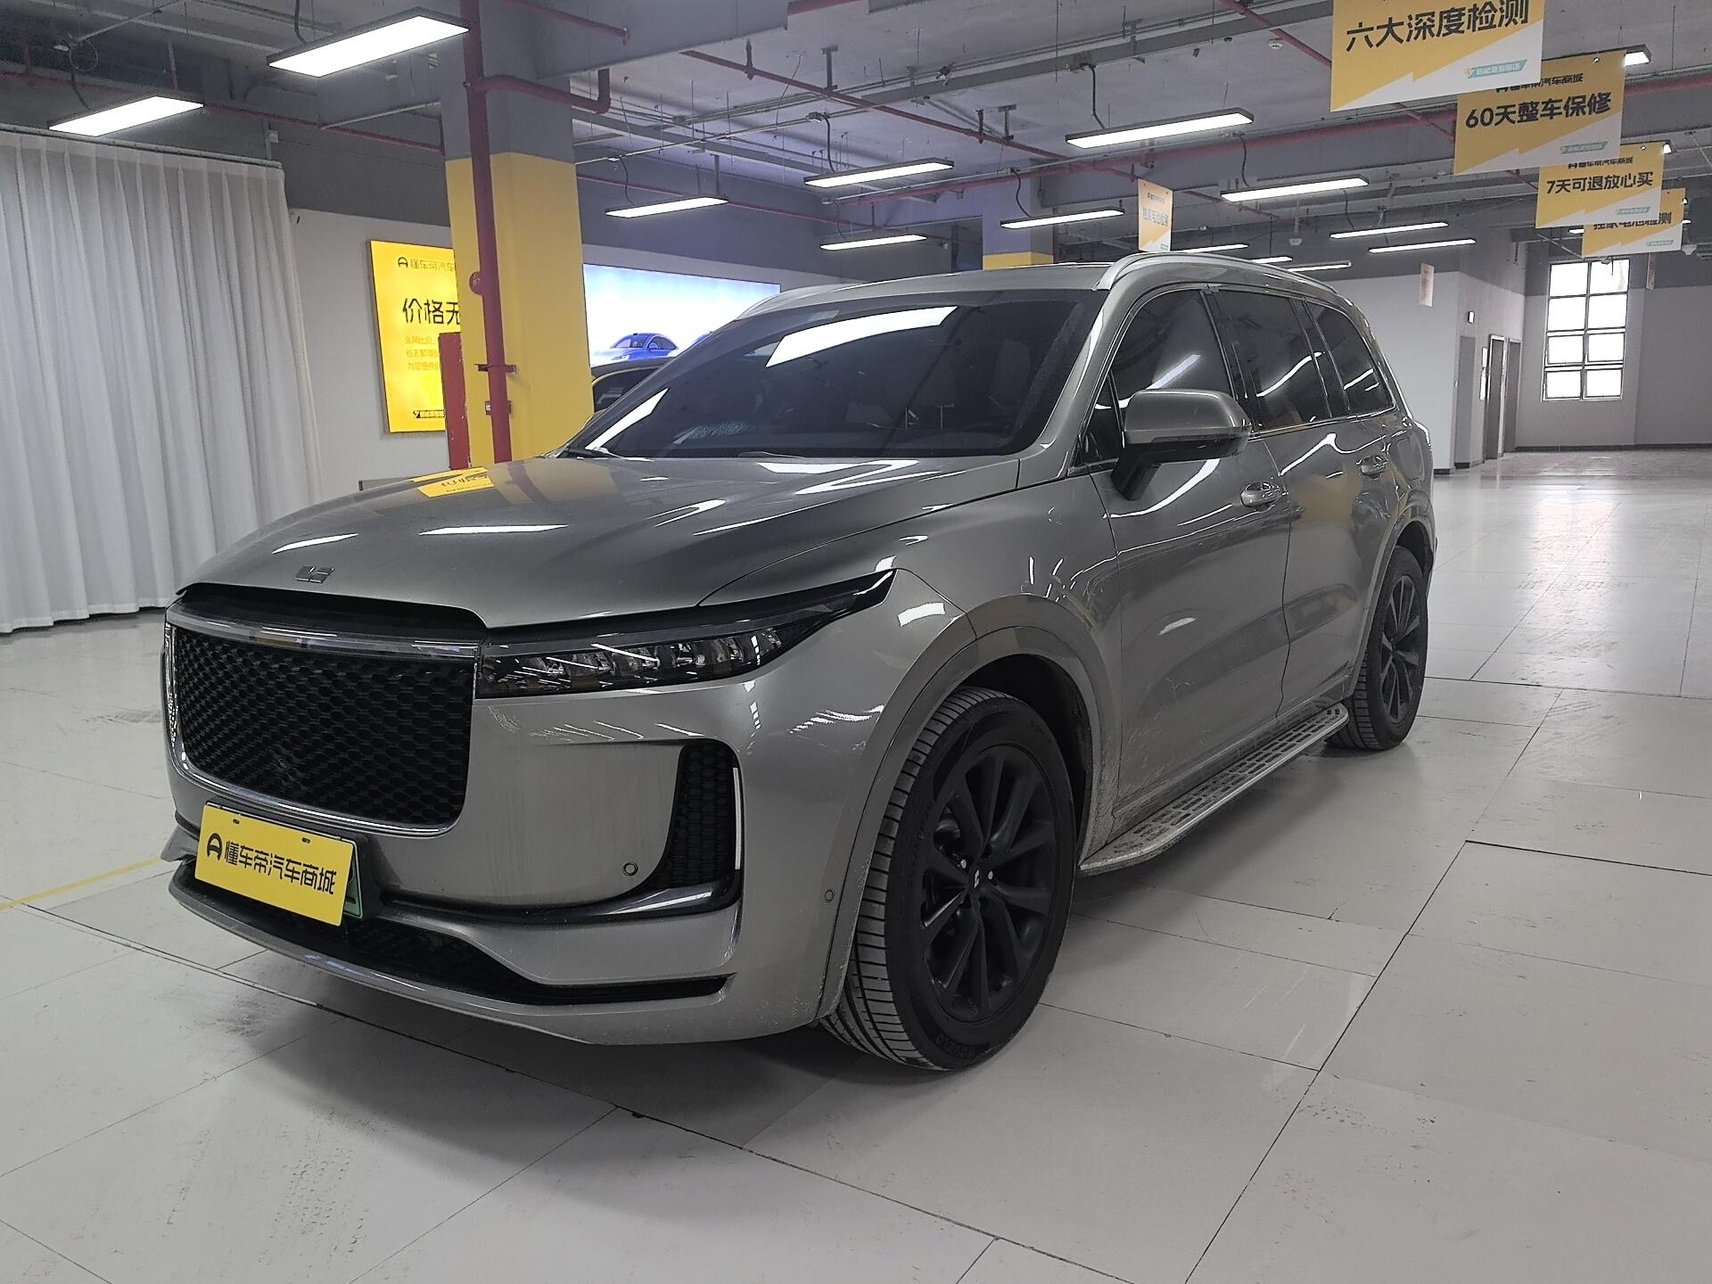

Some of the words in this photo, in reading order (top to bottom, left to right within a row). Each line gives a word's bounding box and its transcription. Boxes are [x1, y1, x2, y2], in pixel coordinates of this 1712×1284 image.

[1345, 0, 1530, 52] 六大深度检测
[1465, 92, 1612, 129] 60天整车保修
[1546, 171, 1654, 195] 7天可退放心买
[402, 298, 460, 325] 价格无
[225, 840, 337, 895] 懂车帝汽车商城
